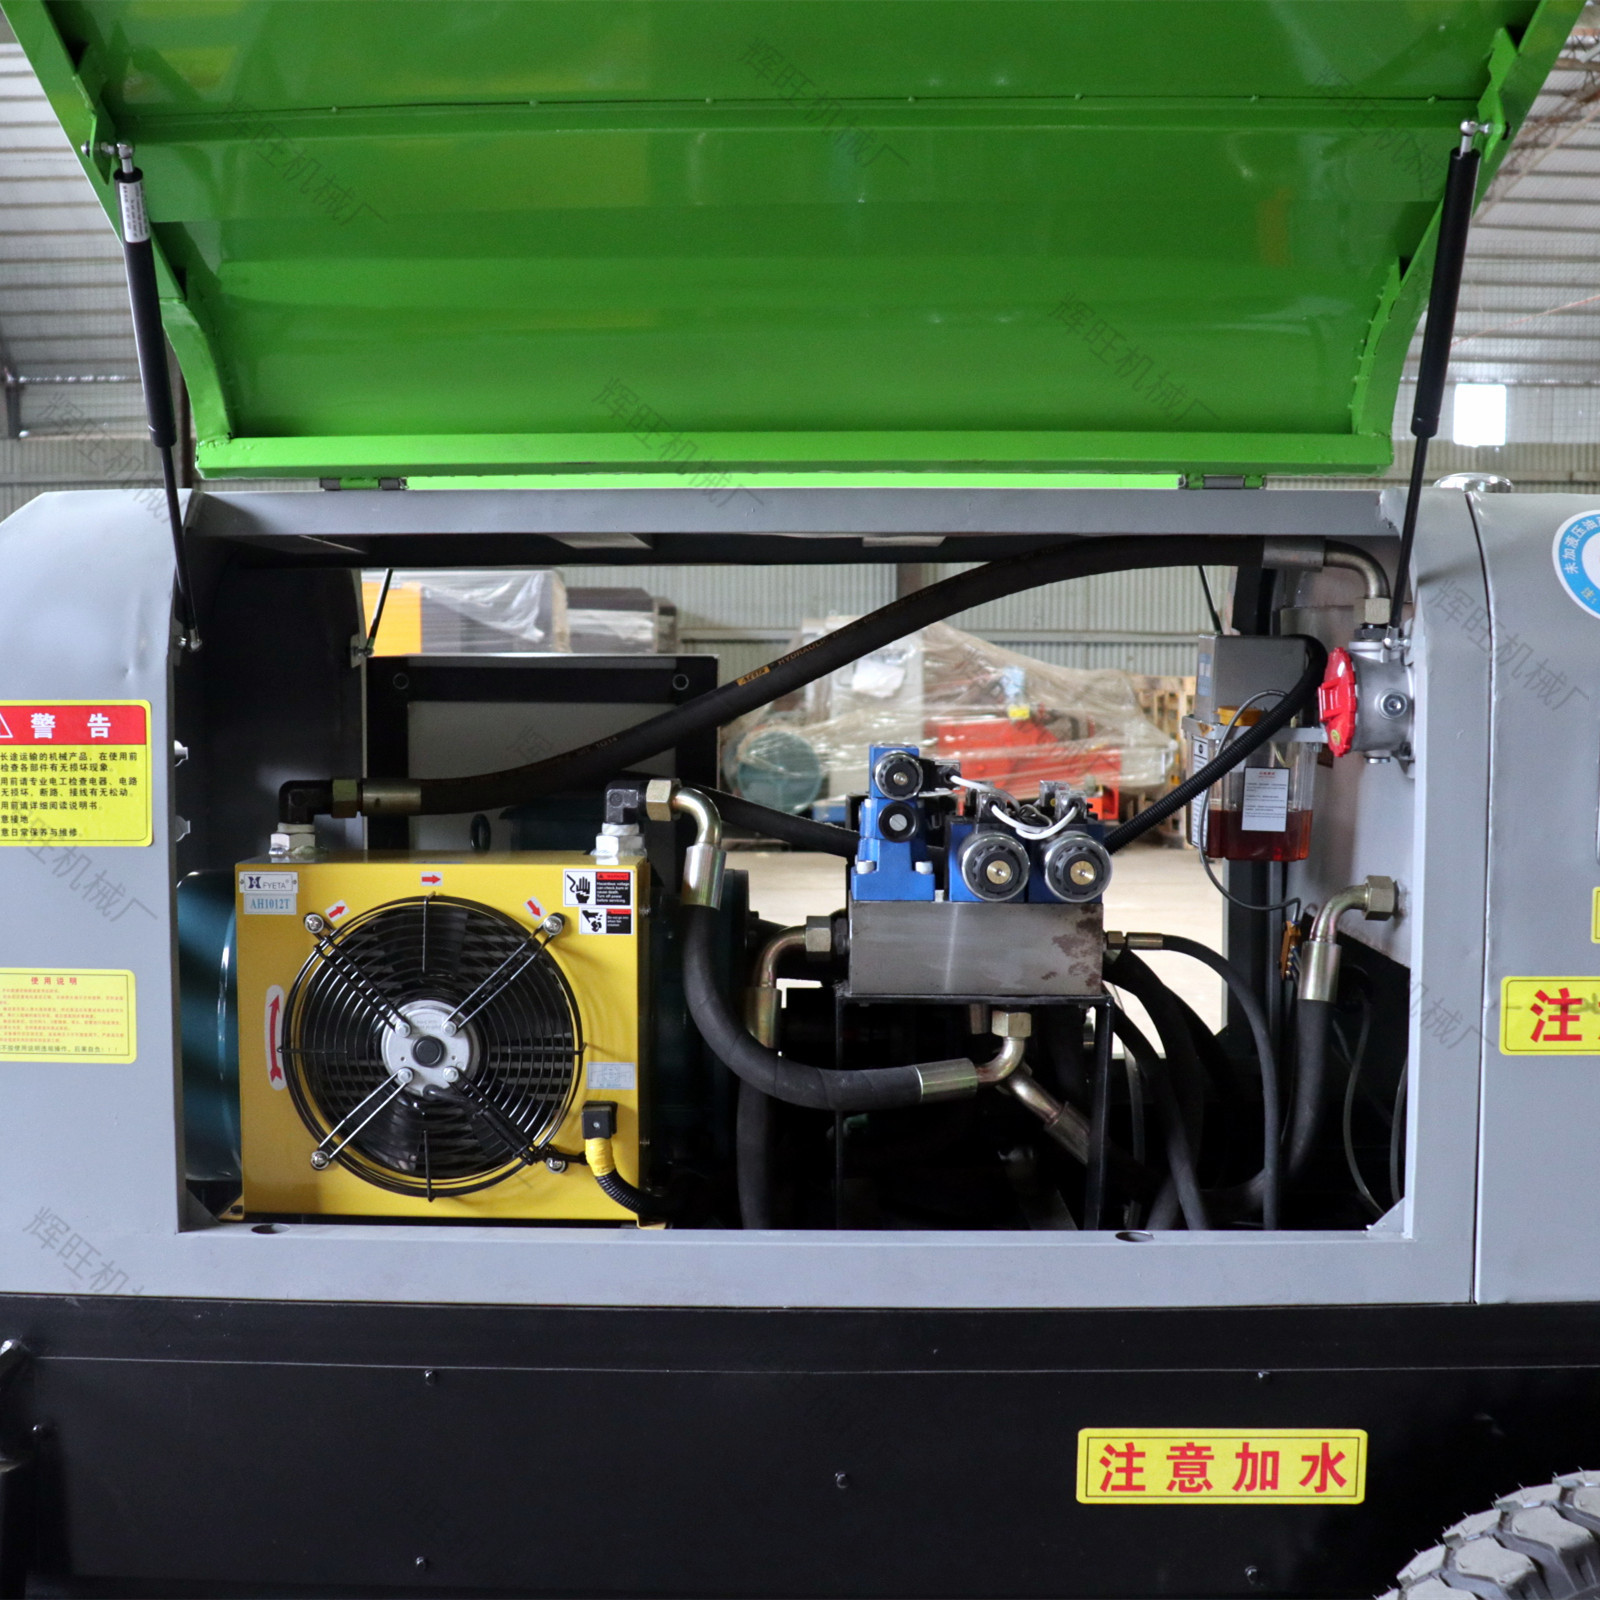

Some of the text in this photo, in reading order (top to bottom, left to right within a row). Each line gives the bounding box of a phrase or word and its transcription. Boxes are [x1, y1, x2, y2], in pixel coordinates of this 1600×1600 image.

[30, 713, 112, 739] 警告
[251, 899, 290, 909] AH1012T
[31, 977, 77, 985] 使用说明
[1530, 987, 1600, 1042] 注
[1099, 1442, 1347, 1493] 注意加水
